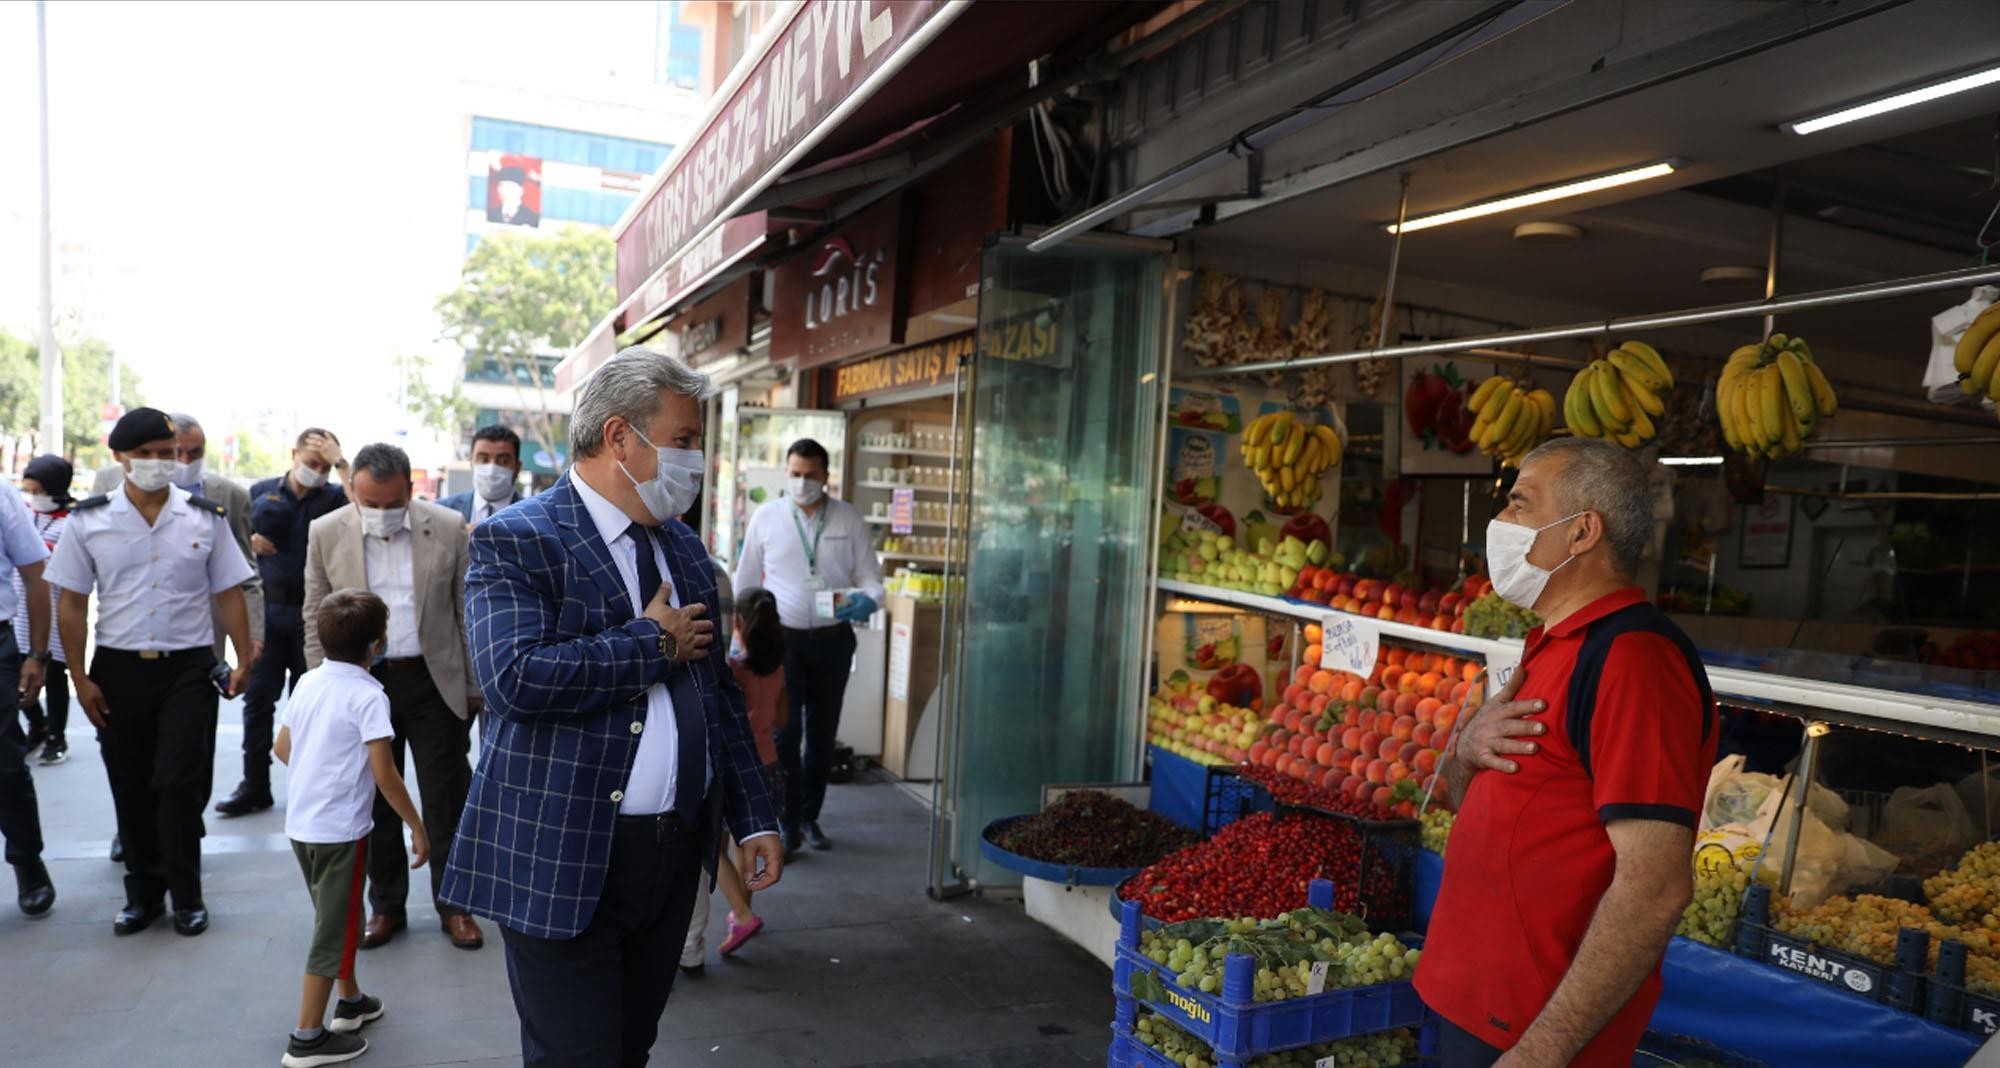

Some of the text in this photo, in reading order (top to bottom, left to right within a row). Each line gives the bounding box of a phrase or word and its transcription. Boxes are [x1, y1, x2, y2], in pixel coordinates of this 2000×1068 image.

[692, 75, 763, 227] SEBZE
[895, 343, 943, 386] SATIŞ
[1771, 943, 1846, 976] KENT
[1167, 990, 1211, 1024] moğlu
